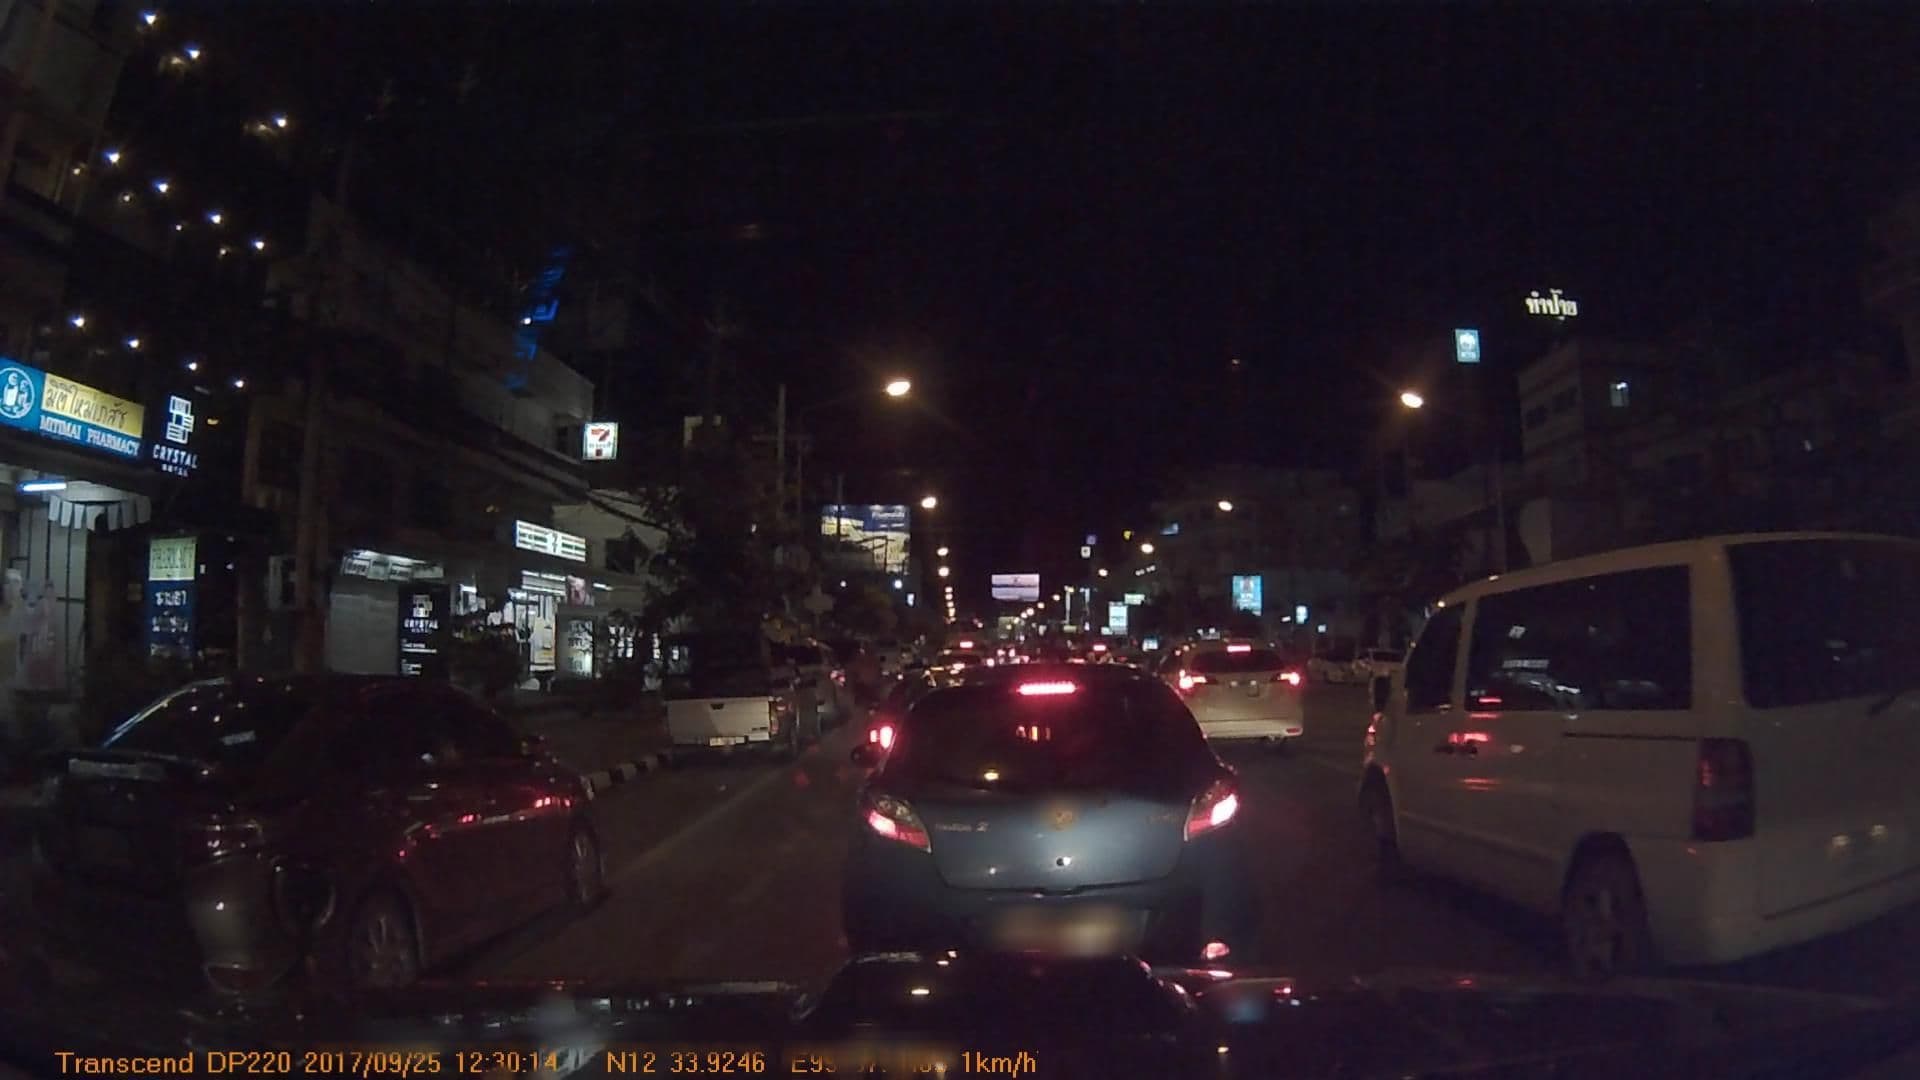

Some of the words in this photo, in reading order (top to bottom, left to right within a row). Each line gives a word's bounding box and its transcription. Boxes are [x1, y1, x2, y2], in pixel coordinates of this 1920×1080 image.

[40, 415, 82, 441] MITIMAI
[86, 428, 141, 457] PHARMACY
[152, 444, 199, 469] CRYSTAL
